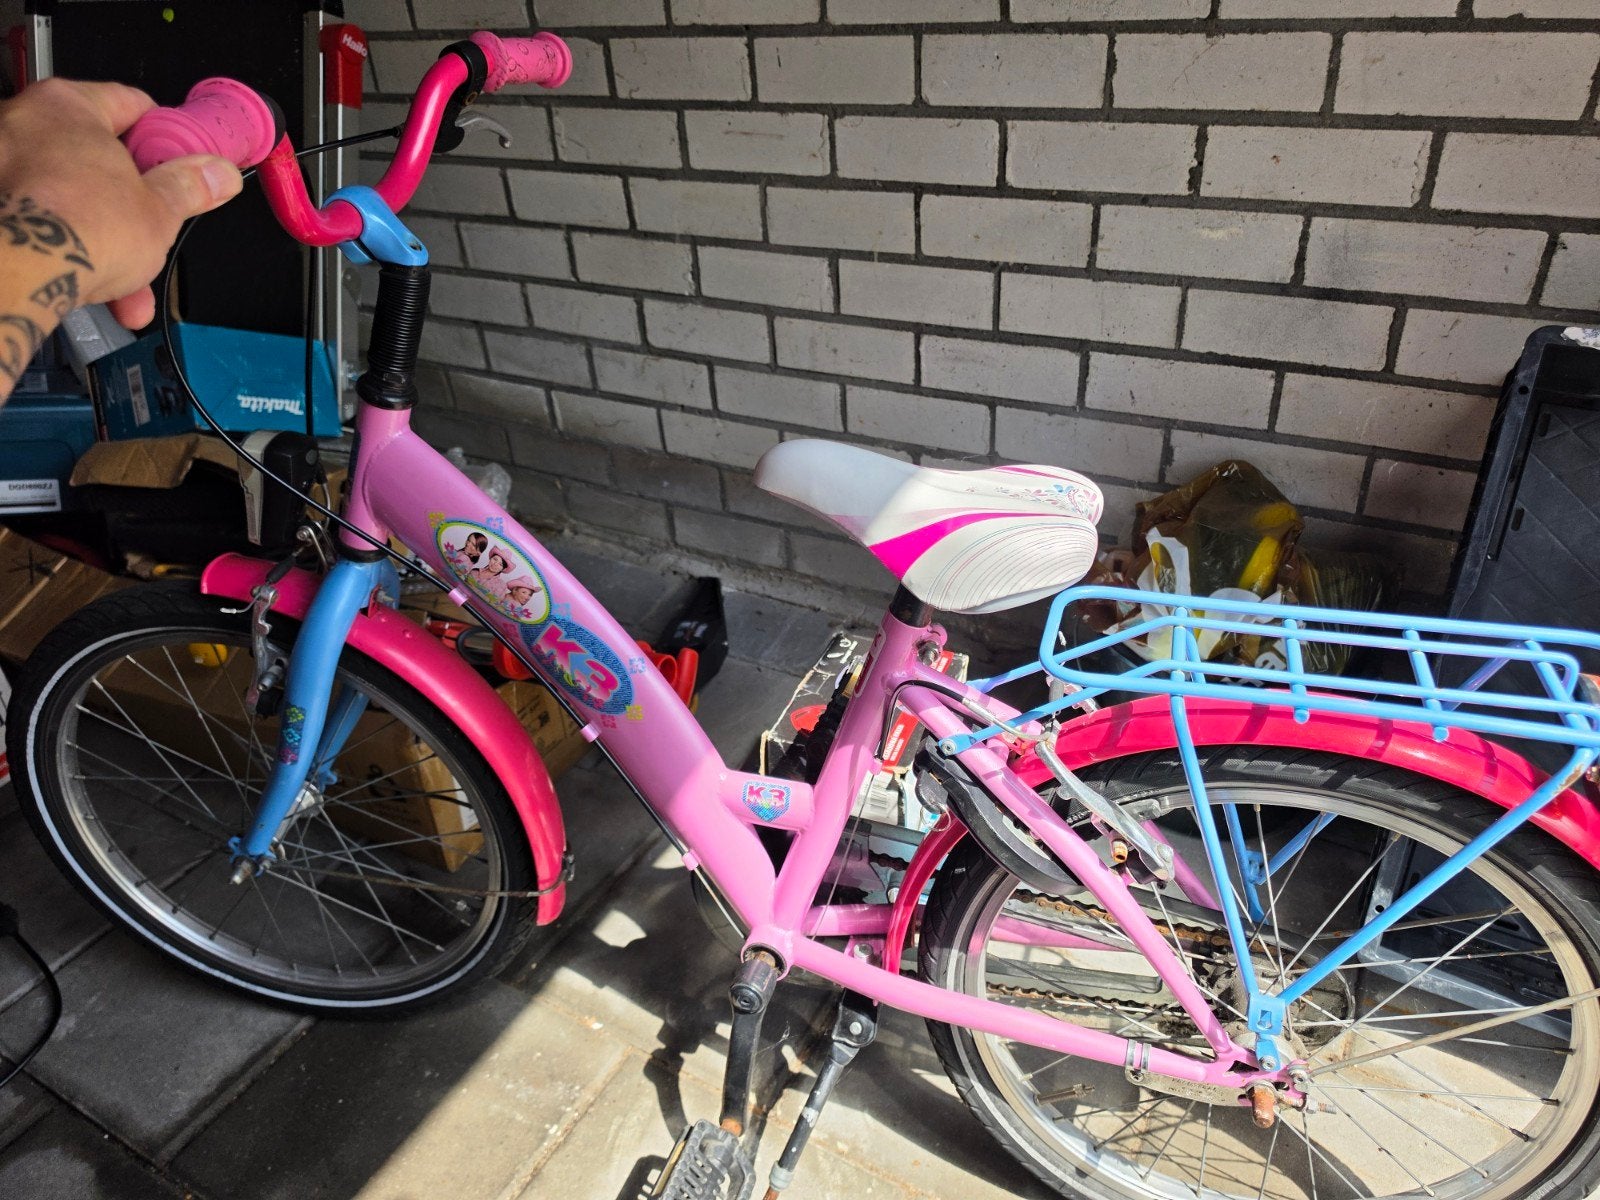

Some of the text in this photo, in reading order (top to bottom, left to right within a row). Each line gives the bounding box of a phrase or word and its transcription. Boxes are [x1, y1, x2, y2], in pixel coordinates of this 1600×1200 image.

[342, 33, 368, 58] Hailo
[537, 622, 620, 702] K3
[747, 784, 787, 807] K3
